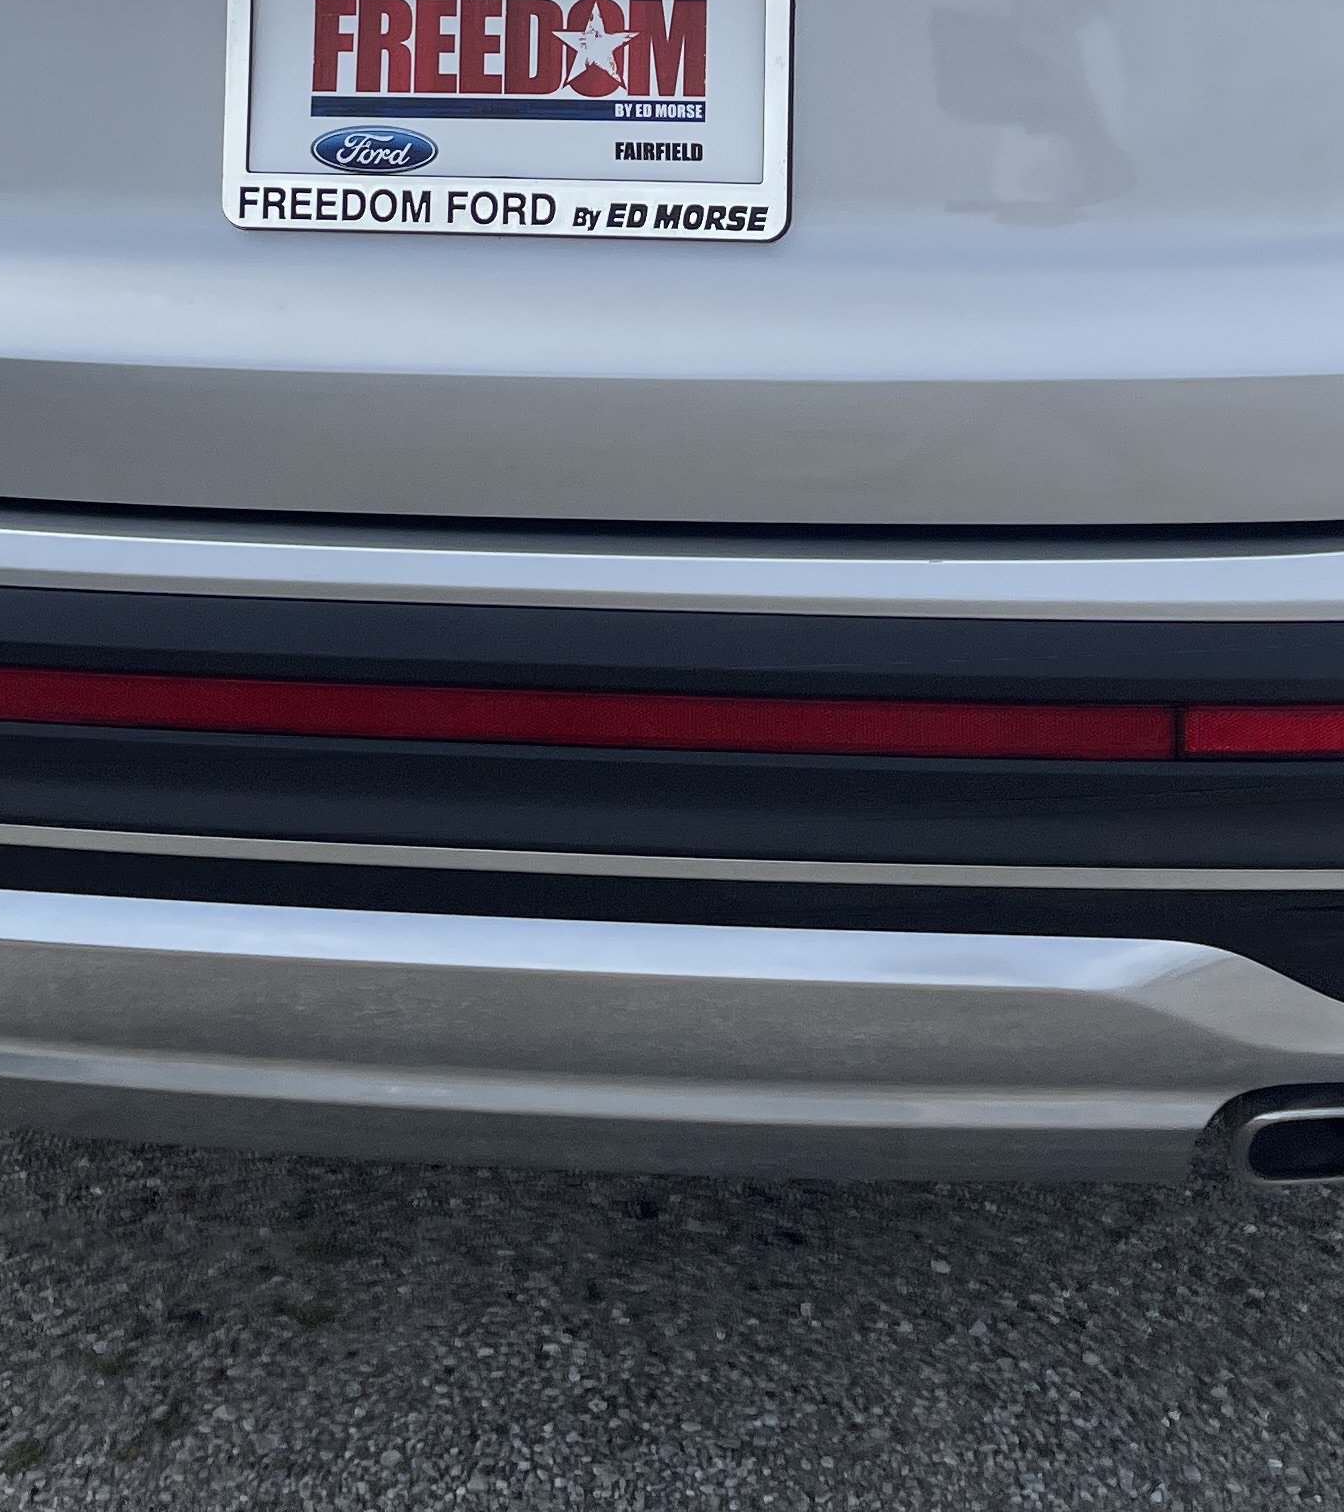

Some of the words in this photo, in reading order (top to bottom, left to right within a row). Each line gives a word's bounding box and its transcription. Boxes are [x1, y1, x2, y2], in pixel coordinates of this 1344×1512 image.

[614, 103, 634, 118] BY
[635, 103, 653, 119] ED
[655, 104, 703, 120] MORSE
[336, 133, 411, 168] Ford
[614, 141, 703, 162] FAIRFIELD
[238, 187, 432, 224] FREEDOM
[447, 190, 556, 227] FORD
[572, 207, 600, 231] By
[606, 202, 648, 229] ED
[653, 204, 770, 232] MORSE
